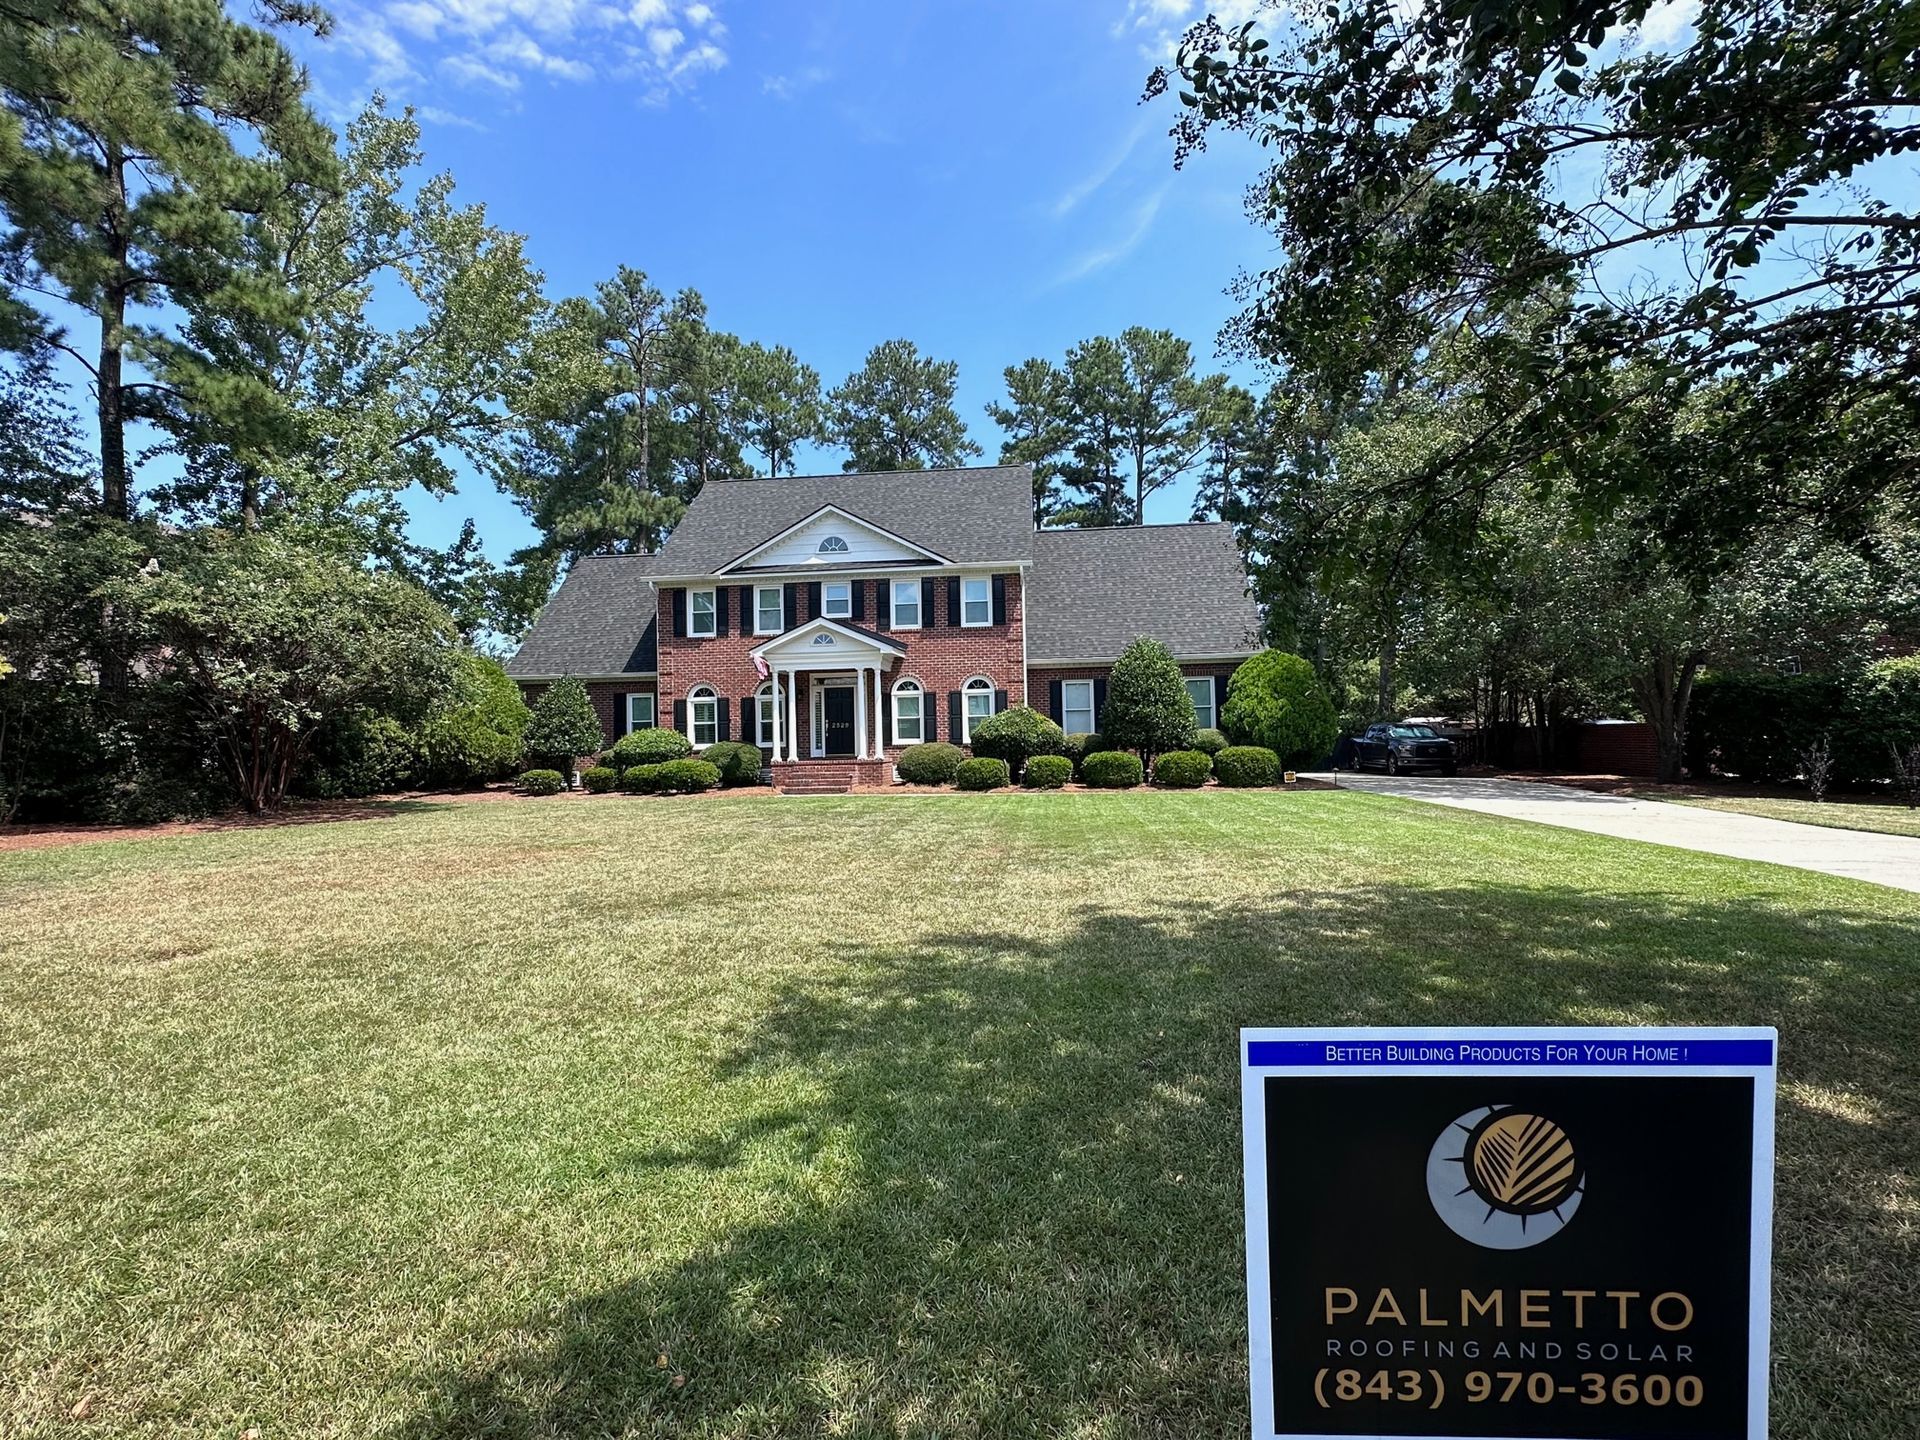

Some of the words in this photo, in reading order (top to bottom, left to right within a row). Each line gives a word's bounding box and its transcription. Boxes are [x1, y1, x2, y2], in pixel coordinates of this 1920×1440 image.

[1325, 1287, 1694, 1331] PALMETTO
[1327, 1339, 1480, 1358] ROOFING
[1493, 1341, 1562, 1359] AND
[1576, 1342, 1692, 1362] SOLAR
[1314, 1368, 1445, 1409] (843)
[1465, 1371, 1703, 1407] 970-3600
